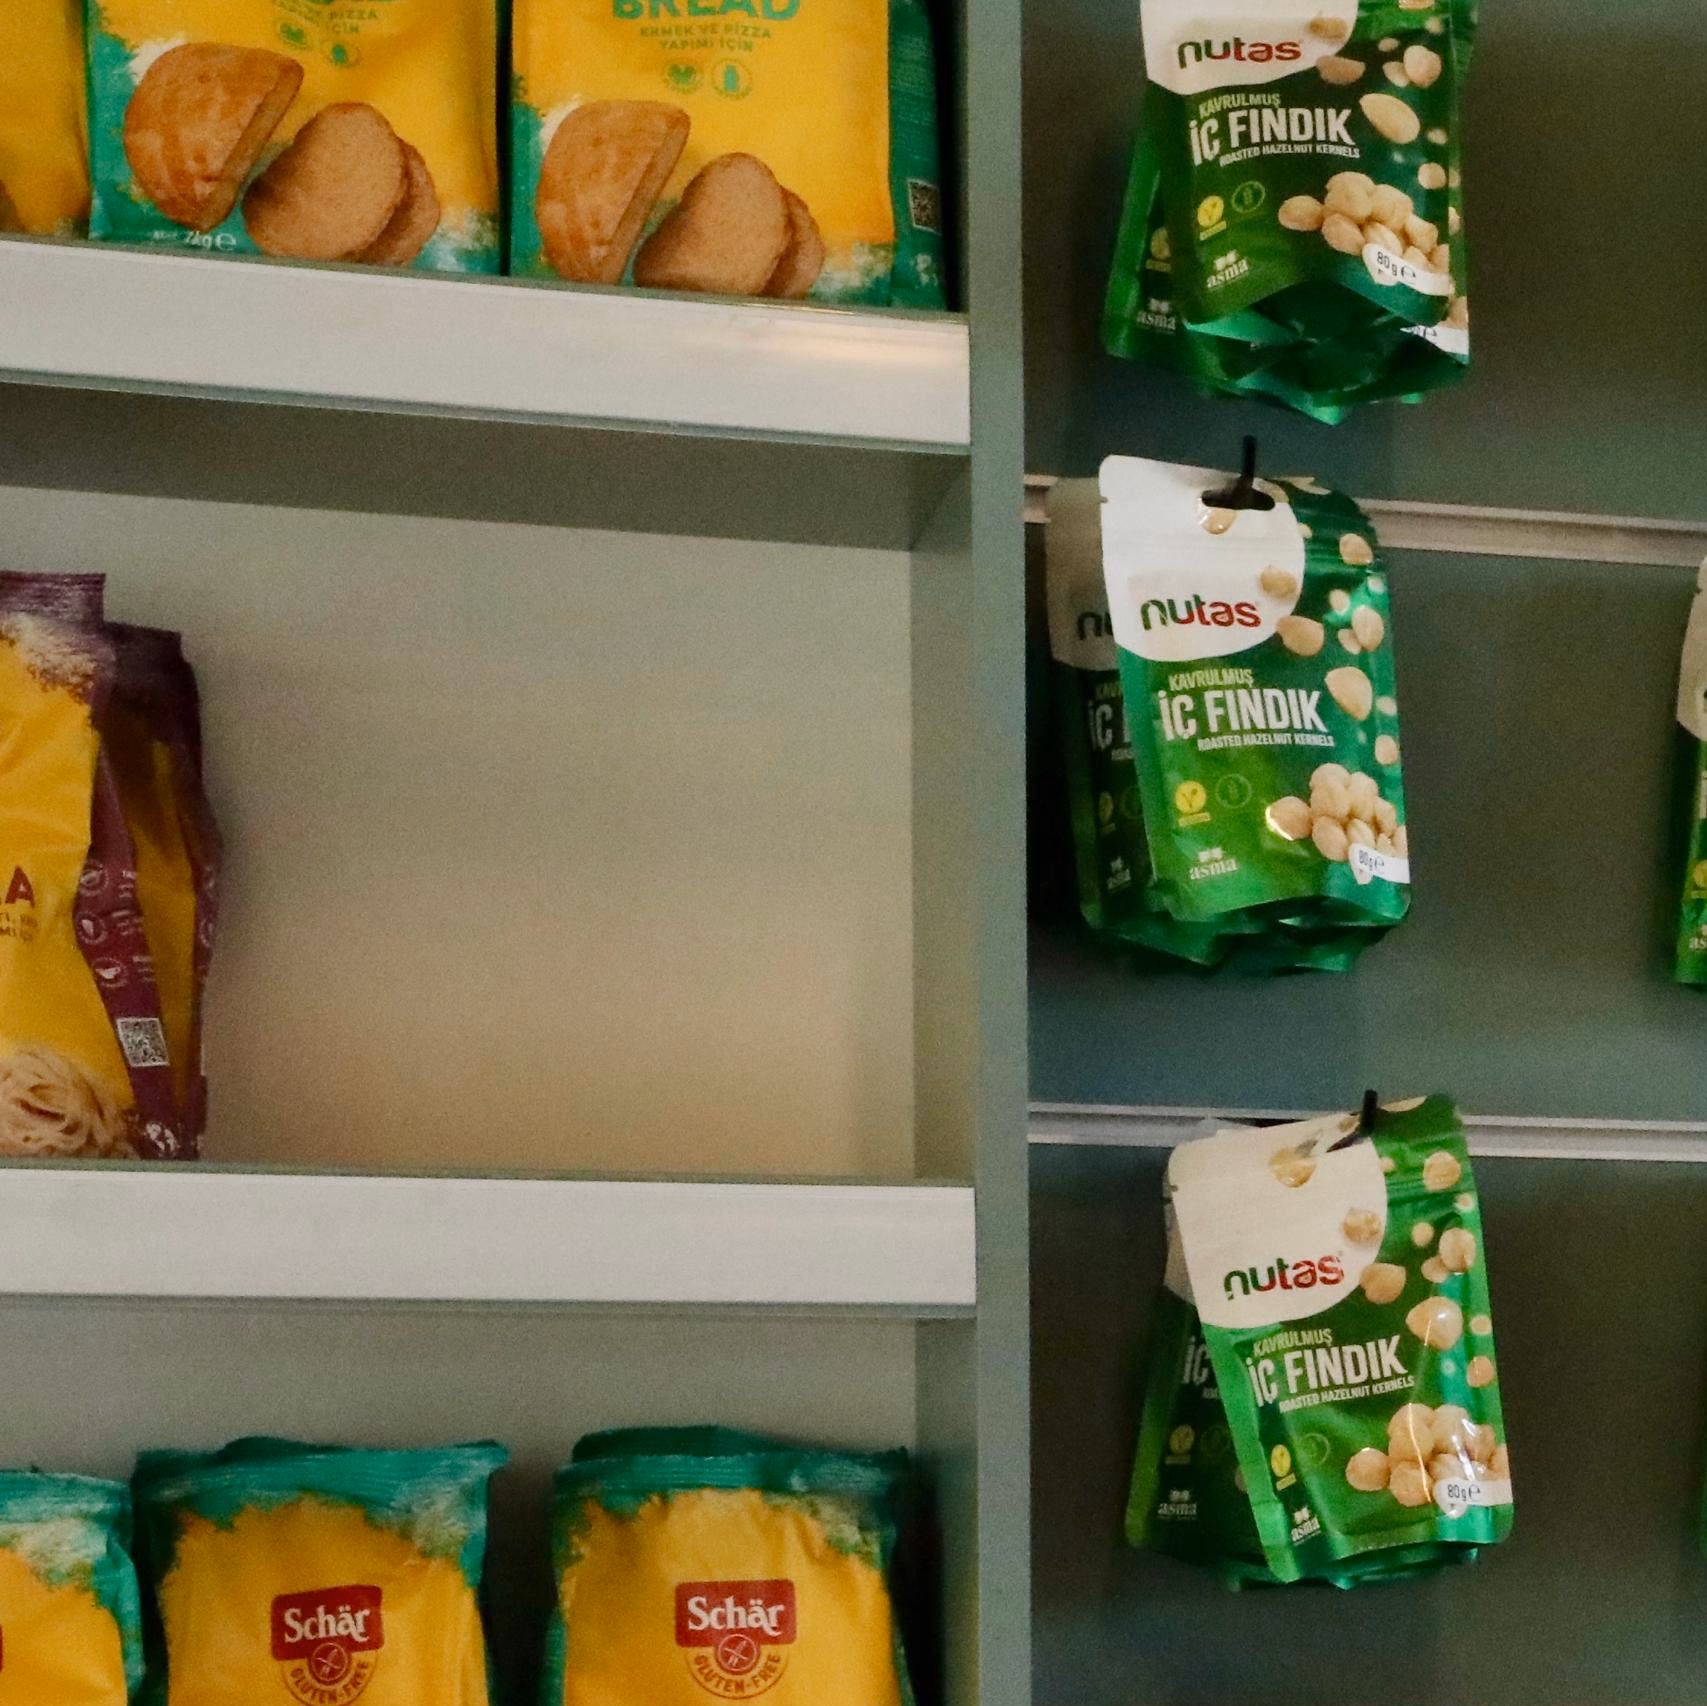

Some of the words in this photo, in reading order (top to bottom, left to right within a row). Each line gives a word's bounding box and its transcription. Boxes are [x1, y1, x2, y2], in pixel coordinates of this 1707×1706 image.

[1178, 37, 1301, 69] nutas
[1229, 108, 1356, 148] FINDIK
[1207, 258, 1249, 289] asma
[1136, 310, 1176, 331] asma
[1140, 593, 1262, 632] nutas
[1204, 688, 1329, 733] FINDIK
[1190, 858, 1238, 880] asma
[1223, 1253, 1345, 1300] nutas
[1284, 1335, 1409, 1394] FINDIK
[1157, 1501, 1199, 1516] asma
[283, 1605, 371, 1643] Schär
[687, 1595, 785, 1637] Schär
[694, 1654, 781, 1694] GLUTEN-FREE
